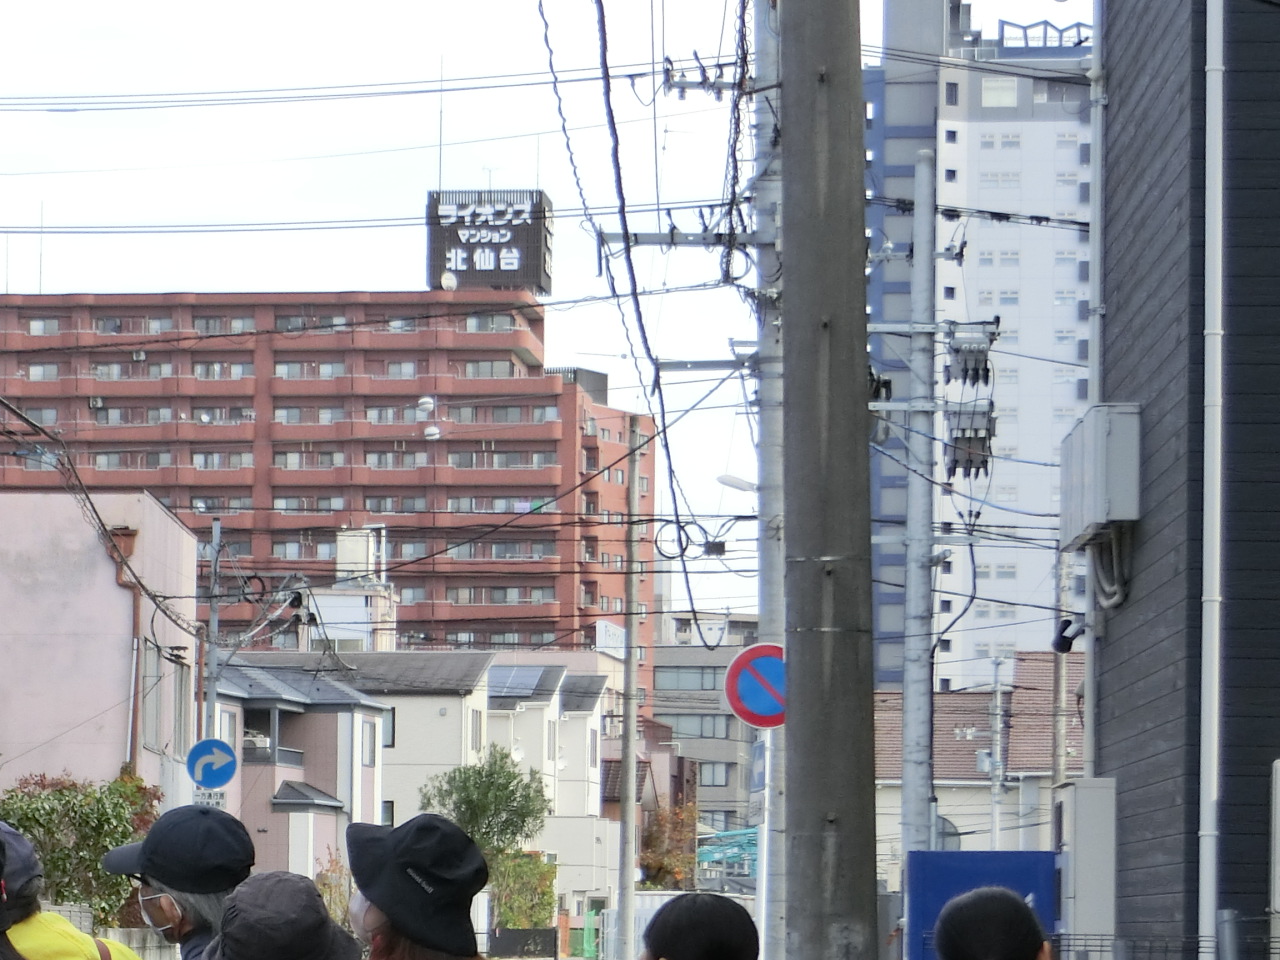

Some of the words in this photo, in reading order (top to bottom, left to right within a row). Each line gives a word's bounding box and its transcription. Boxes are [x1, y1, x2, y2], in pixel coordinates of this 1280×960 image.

[438, 200, 532, 226] ライオンズ
[457, 229, 512, 243] マンション
[446, 248, 519, 270] 北仙台
